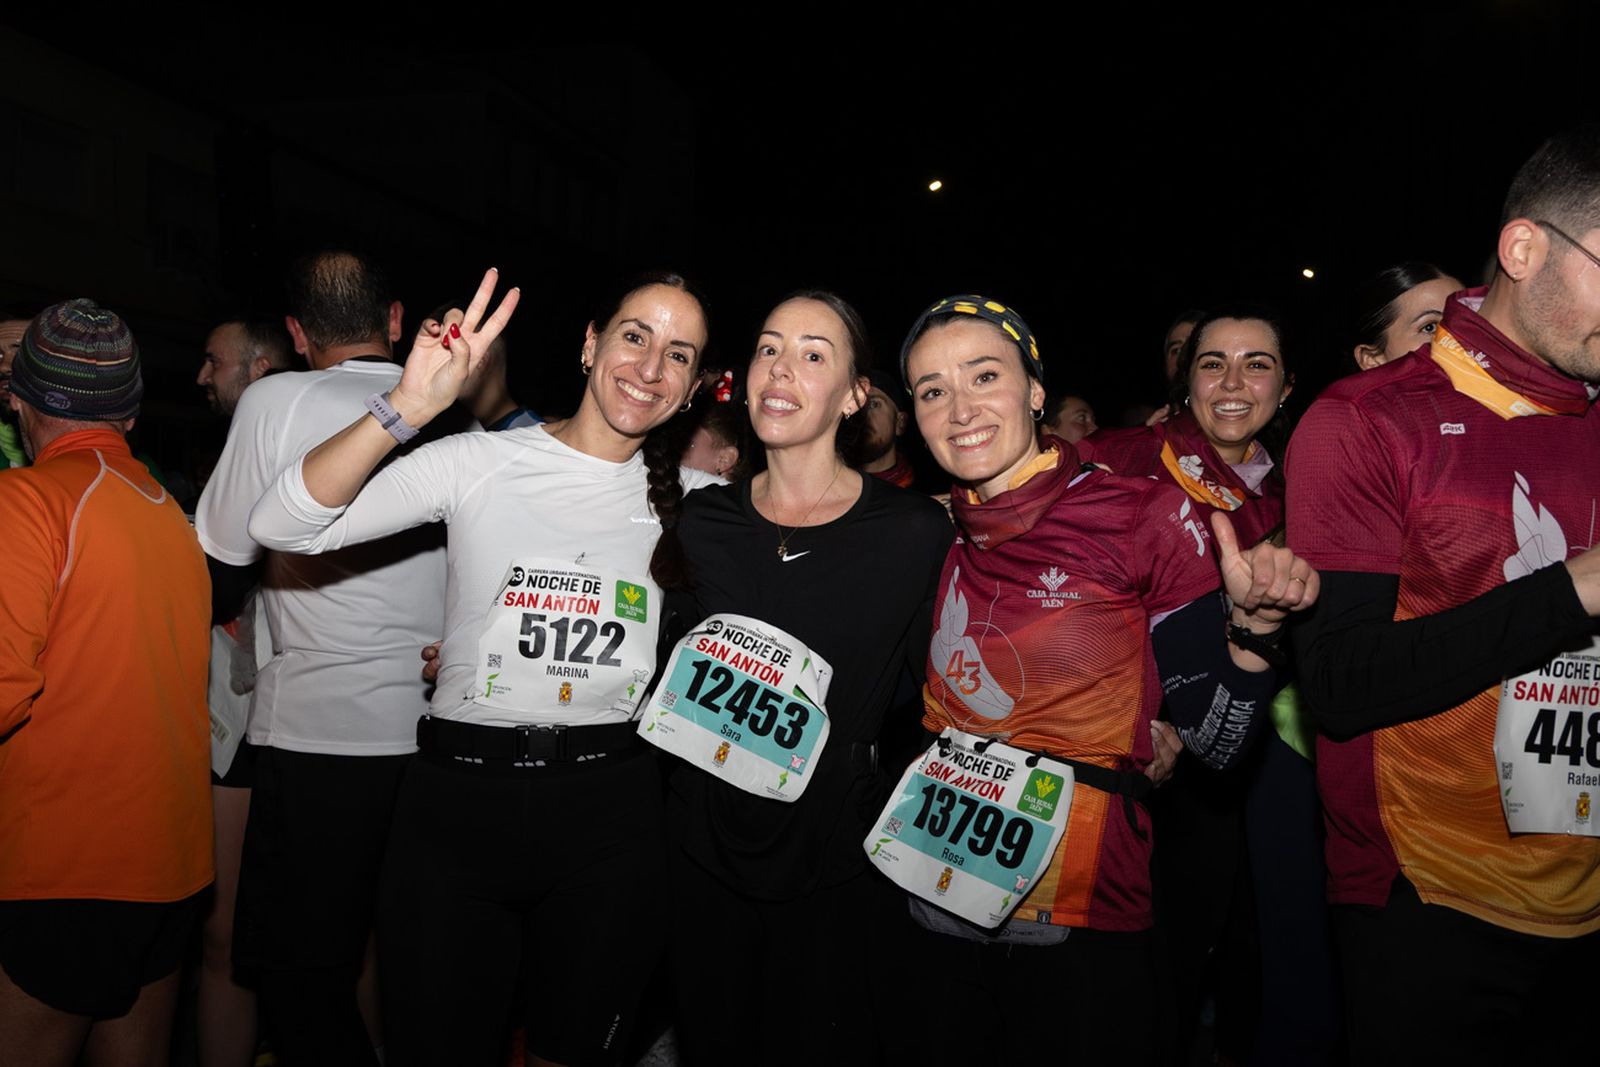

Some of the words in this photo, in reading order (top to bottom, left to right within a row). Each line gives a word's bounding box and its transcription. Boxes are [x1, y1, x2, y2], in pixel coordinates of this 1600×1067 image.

[526, 575, 579, 593] NOCHE
[582, 579, 602, 595] DE
[1048, 591, 1081, 600] RURAL
[504, 592, 539, 609] SAN
[542, 594, 601, 616] ANTÓN
[518, 613, 625, 667] 5122
[722, 628, 770, 659] NOCHE
[771, 648, 792, 668] DE
[546, 665, 589, 679] MARINA
[696, 638, 729, 665] SAN
[729, 652, 784, 687] ANTÓN
[946, 650, 982, 695] 43
[1539, 661, 1590, 680] NOCHE
[1514, 681, 1554, 703] SAN
[685, 659, 810, 751] 12453
[720, 724, 742, 742] Sara
[925, 761, 951, 781] SAN
[949, 752, 993, 777] NOCHE
[993, 764, 1015, 781] DE
[913, 784, 1034, 869] 13799
[941, 847, 965, 866] Rosa
